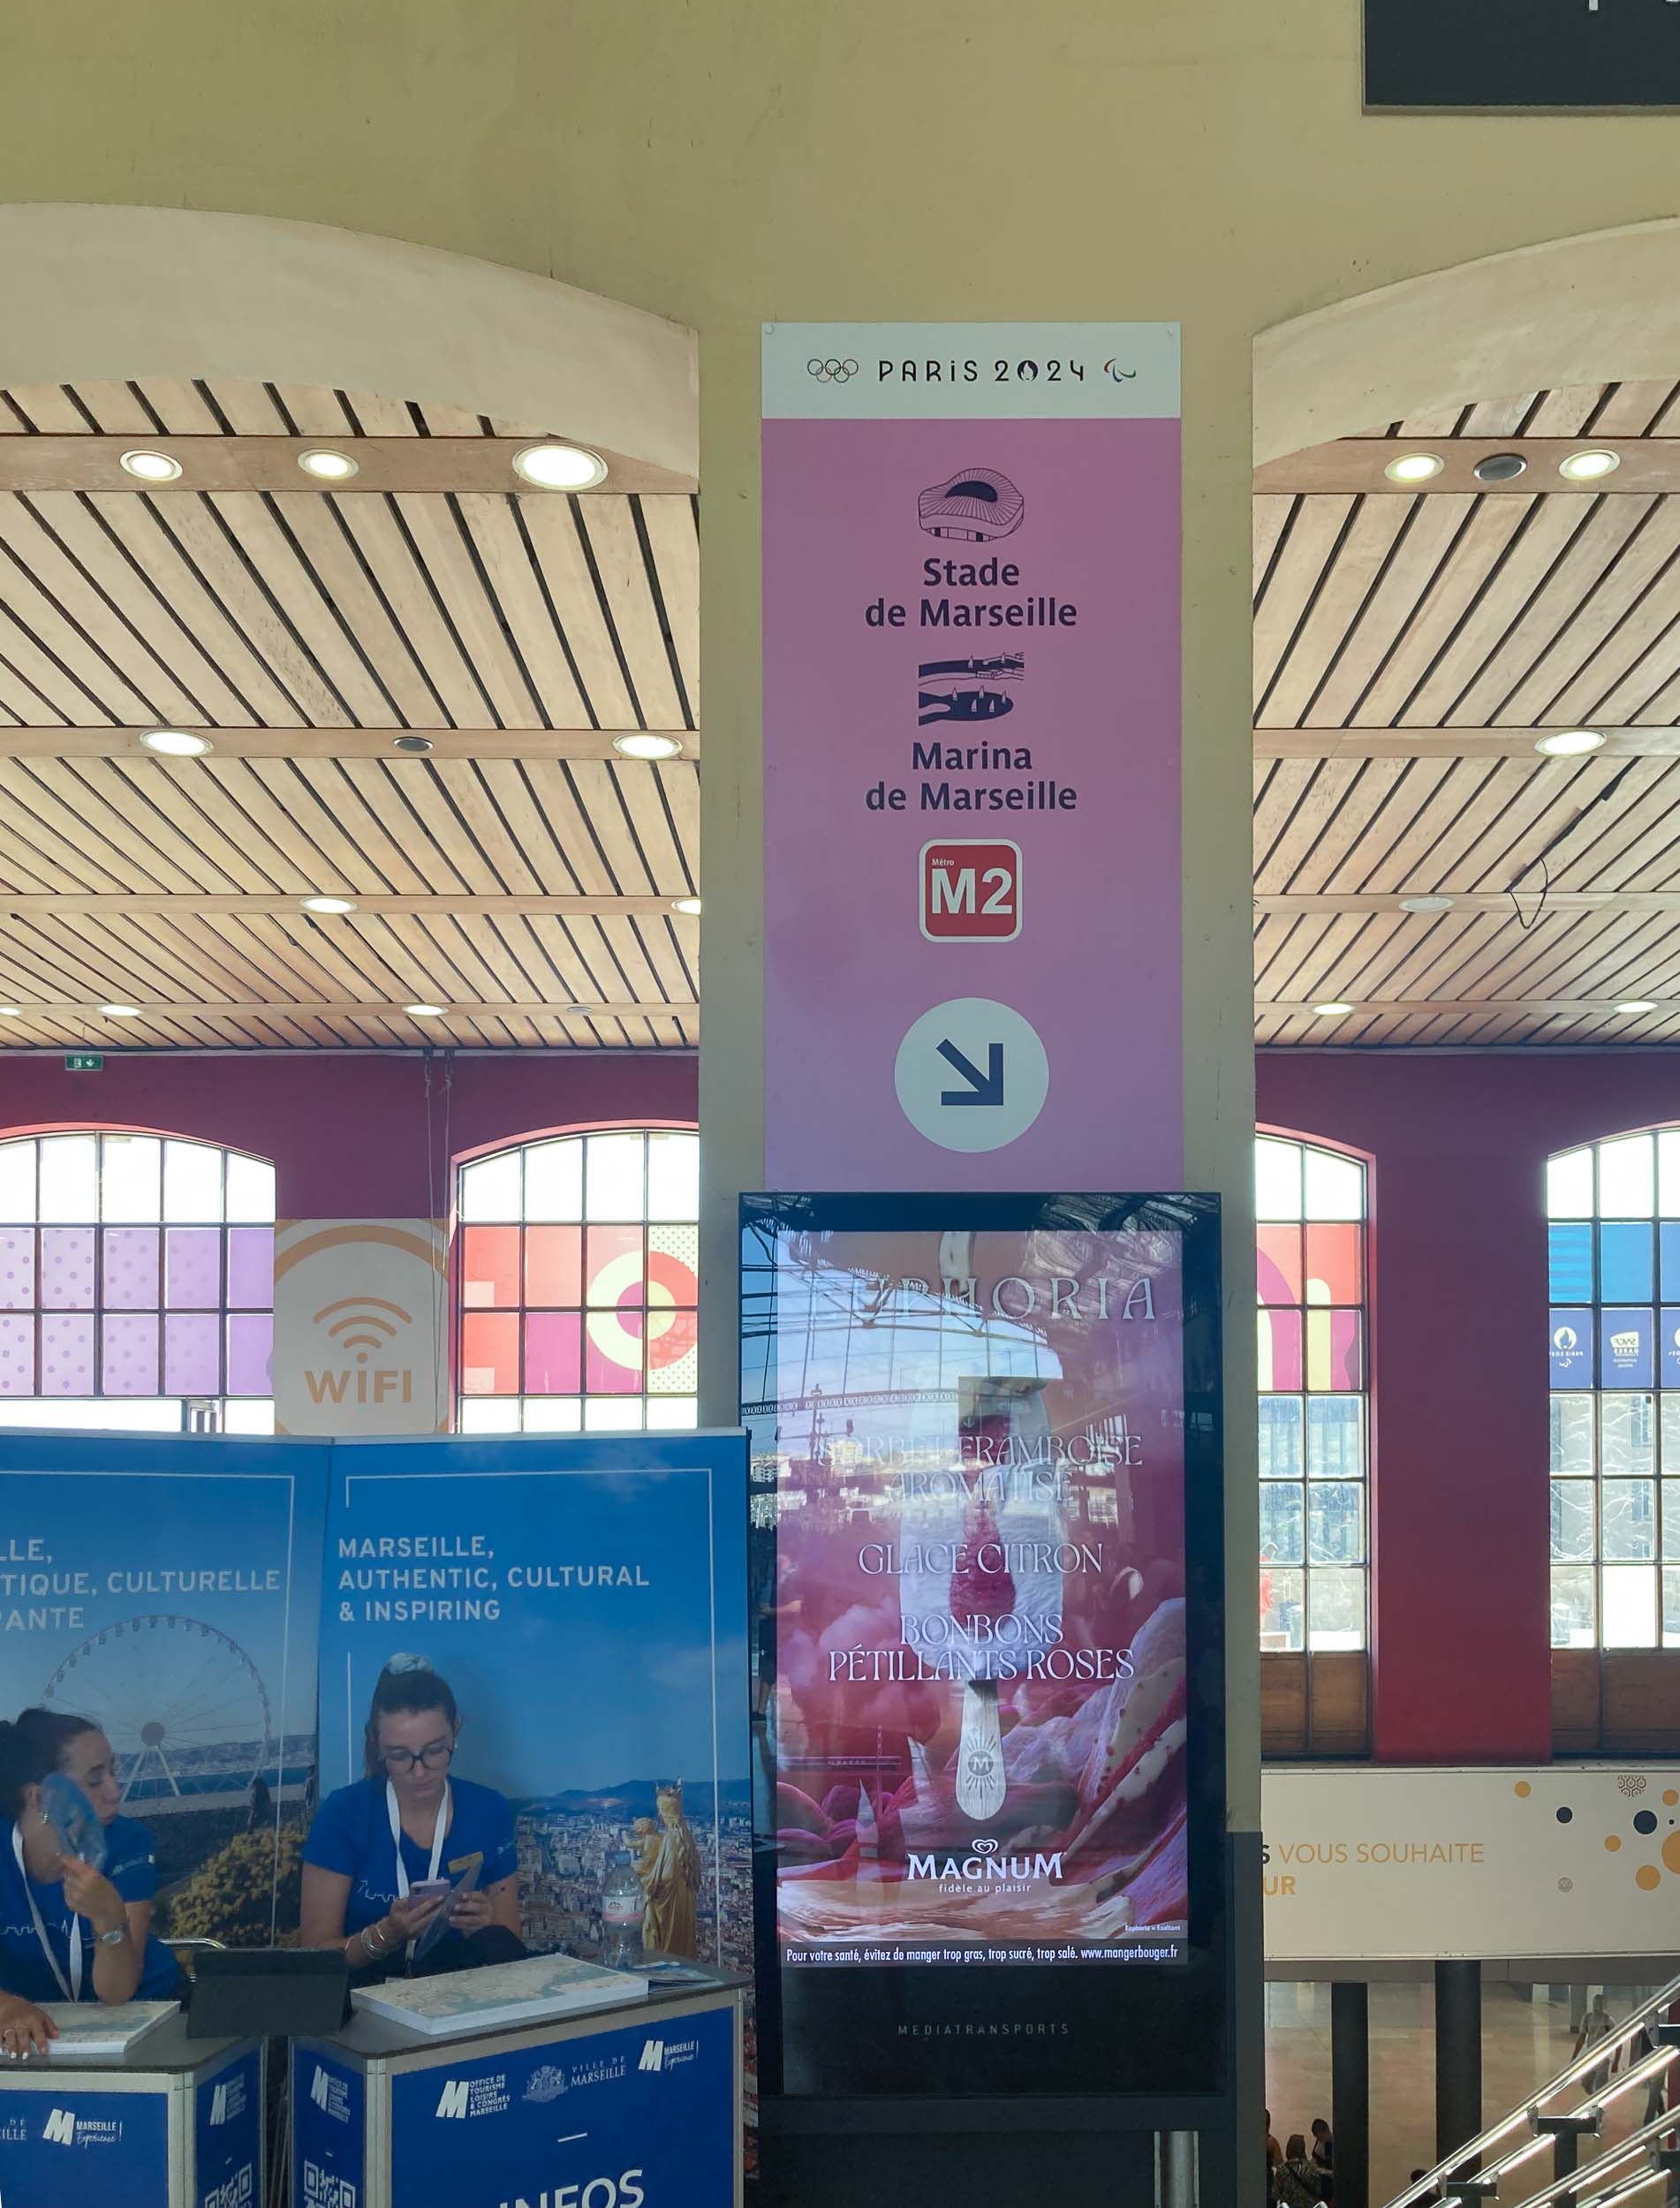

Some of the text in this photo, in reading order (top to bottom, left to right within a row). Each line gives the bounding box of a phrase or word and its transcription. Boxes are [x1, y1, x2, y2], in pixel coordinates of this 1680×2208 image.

[924, 557, 1019, 586] Stade
[866, 597, 1077, 627] de Marseille
[912, 741, 1032, 770] Marina
[866, 781, 1077, 810] de Marseille
[932, 868, 1012, 914] M2
[959, 1433, 1143, 1467] FRAMBOISE
[339, 1536, 495, 1560] MARSEILLE,
[859, 1543, 1102, 1575] GLACE CITRON
[1, 1569, 280, 1597] TIQUE, CULTURELLE
[339, 1566, 649, 1592] AUTHENTIC, CULTURAL
[0, 1607, 84, 1631] ANTE
[339, 1599, 501, 1622] & INSPIRING
[900, 1614, 1063, 1645] BONBONS
[829, 1645, 1134, 1682] PÉTILLANTS ROSES
[907, 1851, 1063, 1879] MAGNUM
[1279, 1843, 1348, 1864] VOUS
[1357, 1843, 1484, 1864] SOUHAITE
[939, 1883, 972, 1893] fidèle
[995, 1883, 1032, 1894] plaisir
[786, 1944, 1178, 1962] Pour votre santé, évitez de manger trop gras, trop sucré, trop salé. www.mangerbouger.fr
[898, 2023, 1068, 2036] MEDIATRANSPORTS
[664, 2041, 695, 2055] MARSEILLE
[571, 2065, 626, 2087] MARSEILLE
[0, 2127, 26, 2140] ILLE
[77, 2121, 117, 2131] MARSEILLE
